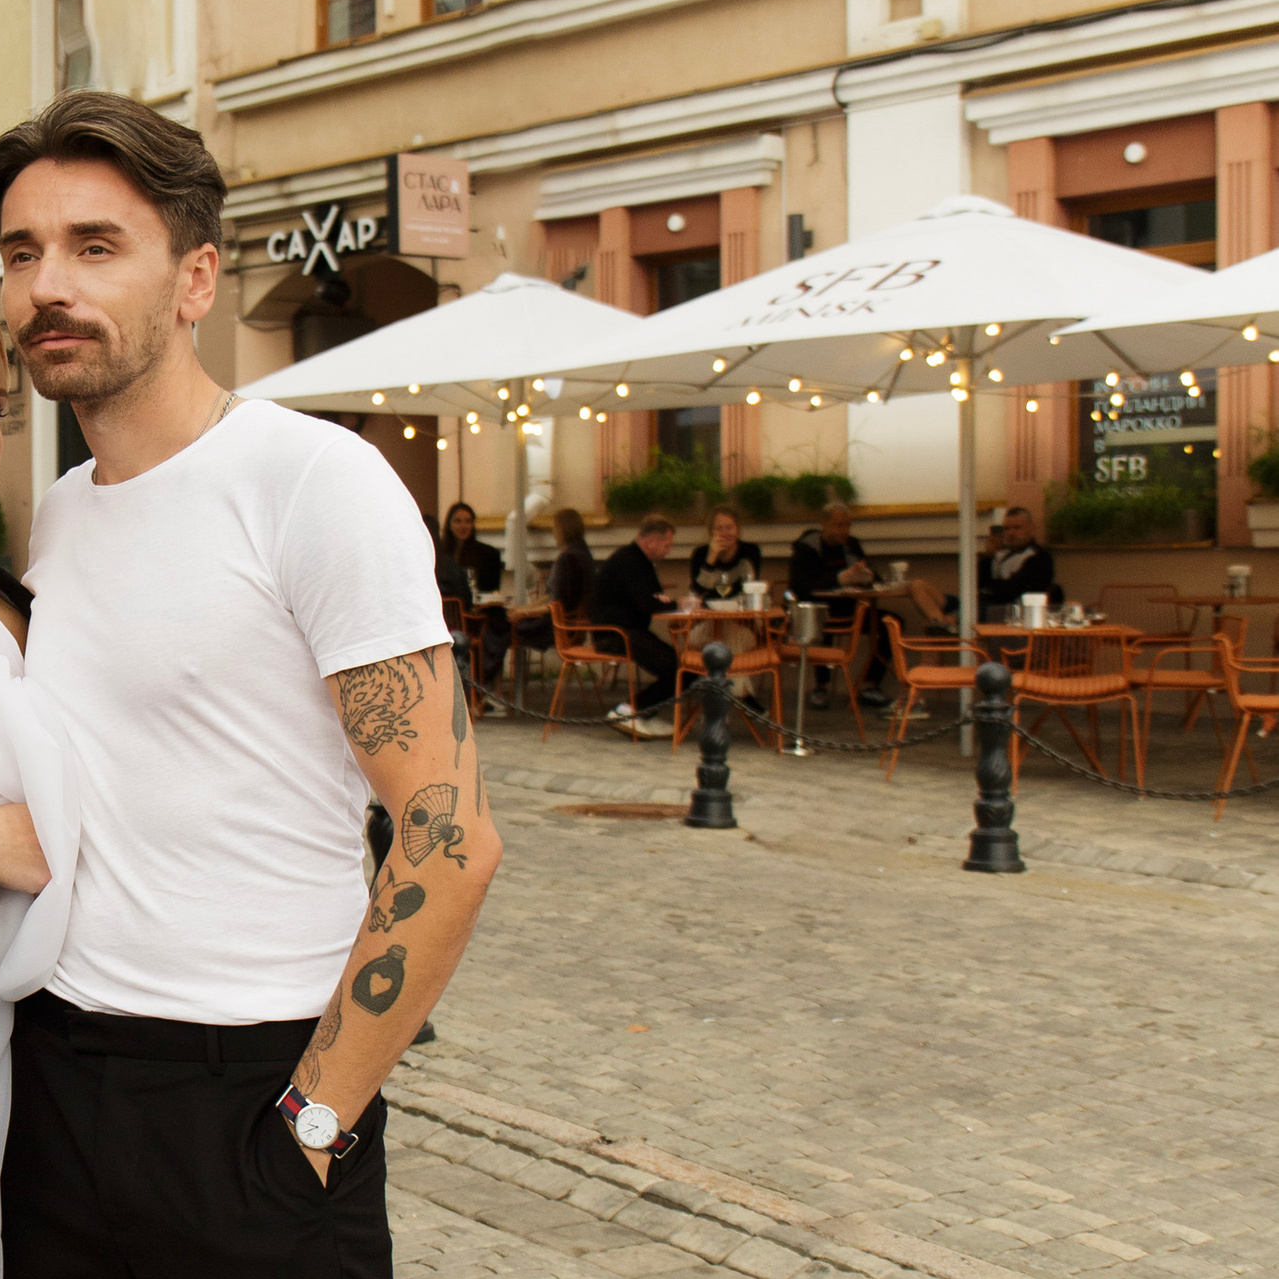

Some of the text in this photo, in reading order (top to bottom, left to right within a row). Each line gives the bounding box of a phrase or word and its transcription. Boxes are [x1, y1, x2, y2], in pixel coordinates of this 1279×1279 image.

[266, 204, 378, 277] САХАР
[767, 258, 943, 306] SFB
[1094, 454, 1148, 483] SFB
